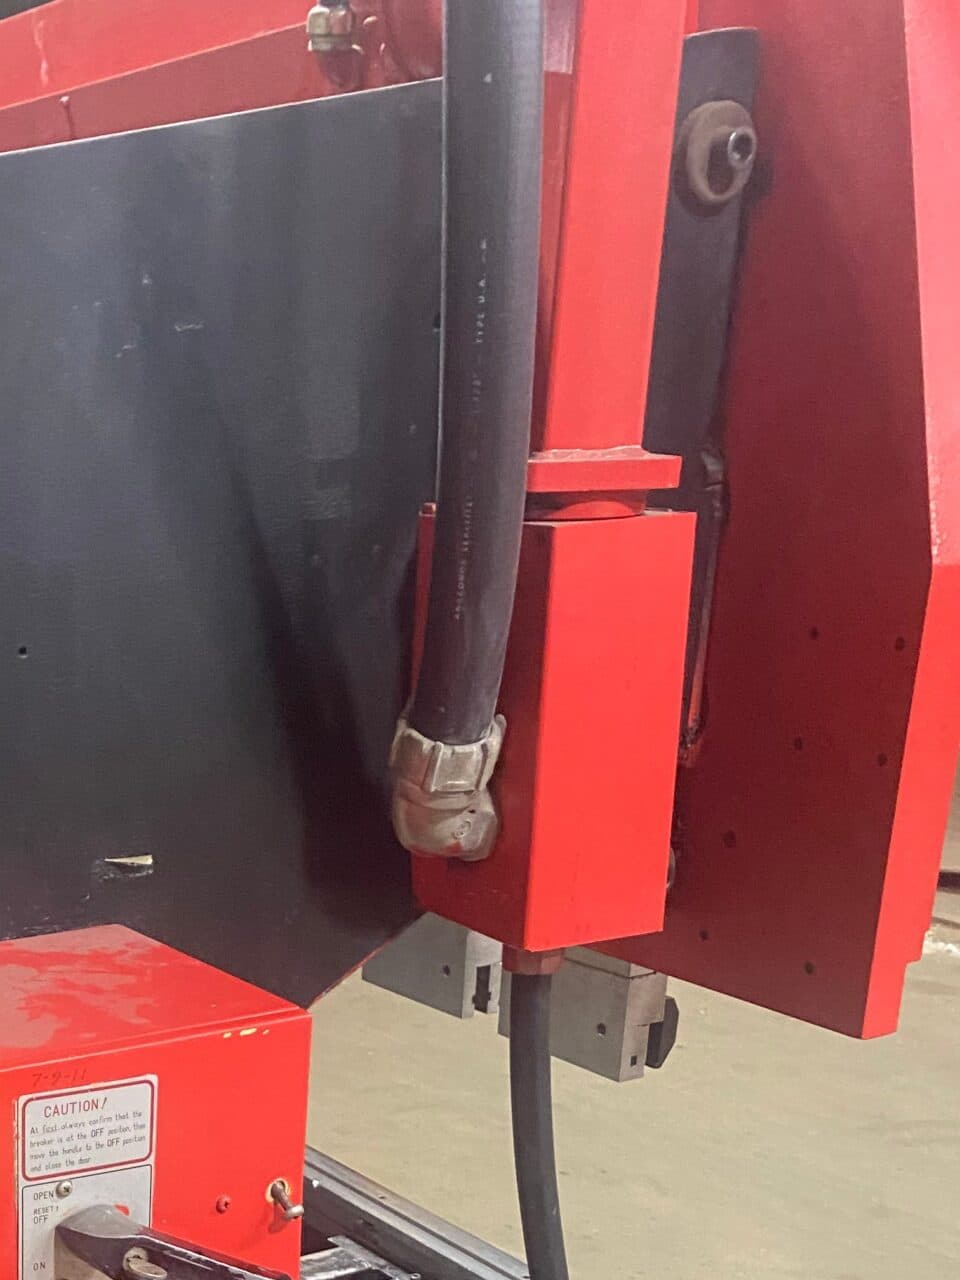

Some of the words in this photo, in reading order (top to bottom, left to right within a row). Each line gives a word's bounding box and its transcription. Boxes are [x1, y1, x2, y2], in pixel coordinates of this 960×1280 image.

[115, 1111, 129, 1121] that
[77, 1131, 87, 1140] the
[90, 1127, 105, 1138] OFF
[49, 1149, 59, 1157] the
[95, 1140, 105, 1149] the
[107, 1137, 121, 1147] OFF
[33, 1190, 54, 1201] OPEN
[33, 1214, 48, 1224] OFF
[33, 1262, 46, 1271] ON
